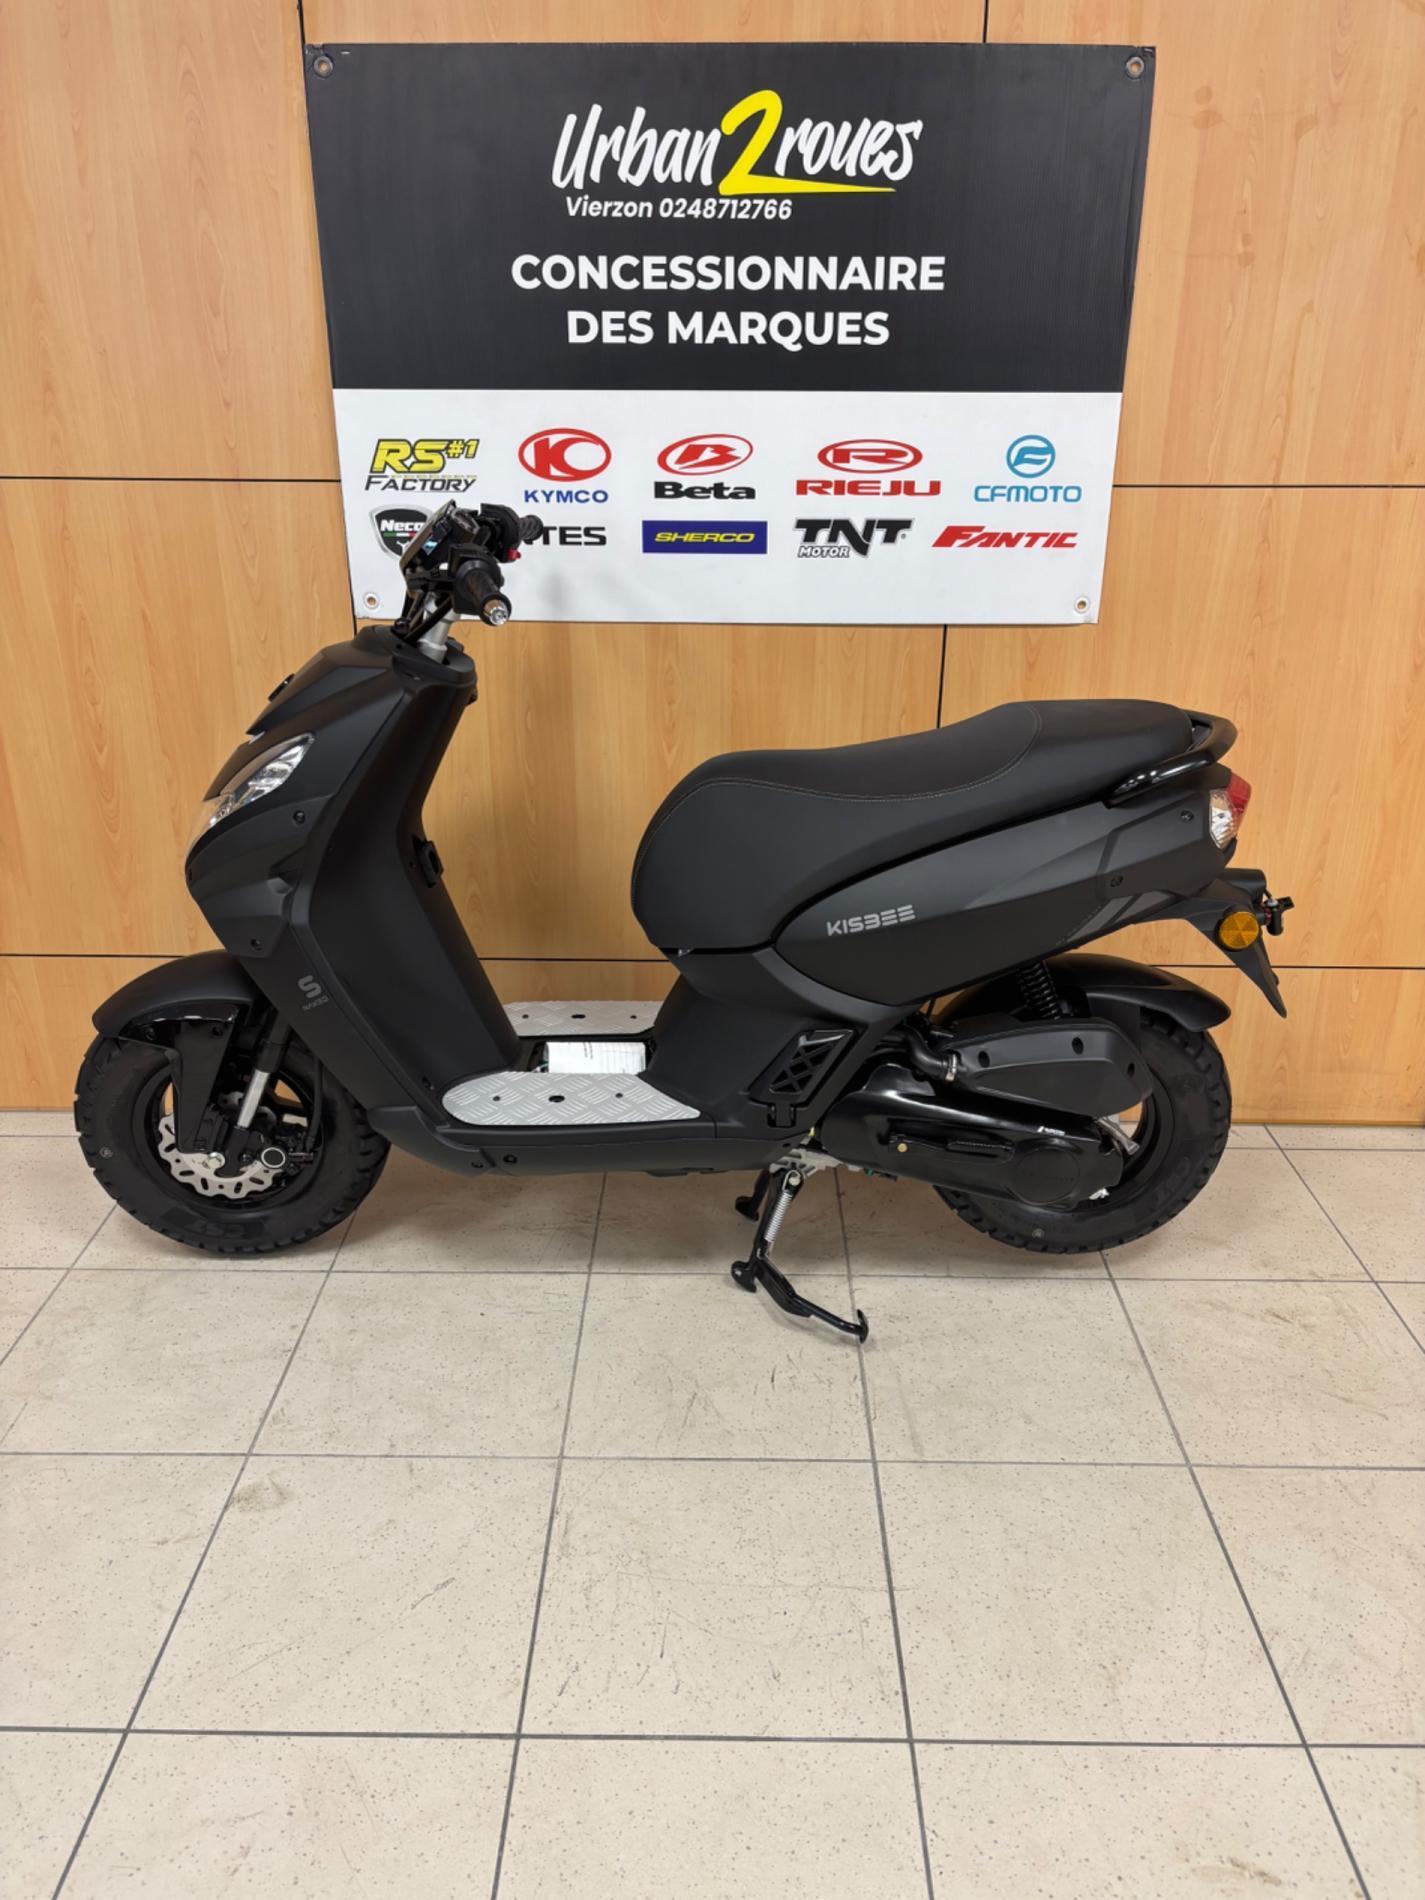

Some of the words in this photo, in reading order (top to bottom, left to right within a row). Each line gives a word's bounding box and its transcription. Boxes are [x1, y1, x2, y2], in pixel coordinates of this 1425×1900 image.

[565, 196, 653, 218] Vierzon
[658, 198, 793, 220] 0248712766
[511, 254, 946, 290] CONCESSIONNAIRE
[567, 310, 653, 344] DES
[667, 311, 890, 352] MARQUES
[365, 475, 477, 492] FACTORY
[654, 481, 756, 499] Beta
[796, 480, 941, 496] RIEJU
[524, 490, 609, 504] KYMCO
[973, 485, 1082, 503] CFMOTO
[655, 532, 755, 542] SHERCO
[793, 518, 913, 557] TNT
[931, 526, 1078, 548] FANTIC
[798, 545, 850, 558] MOTOR
[827, 904, 916, 937] KISBEE
